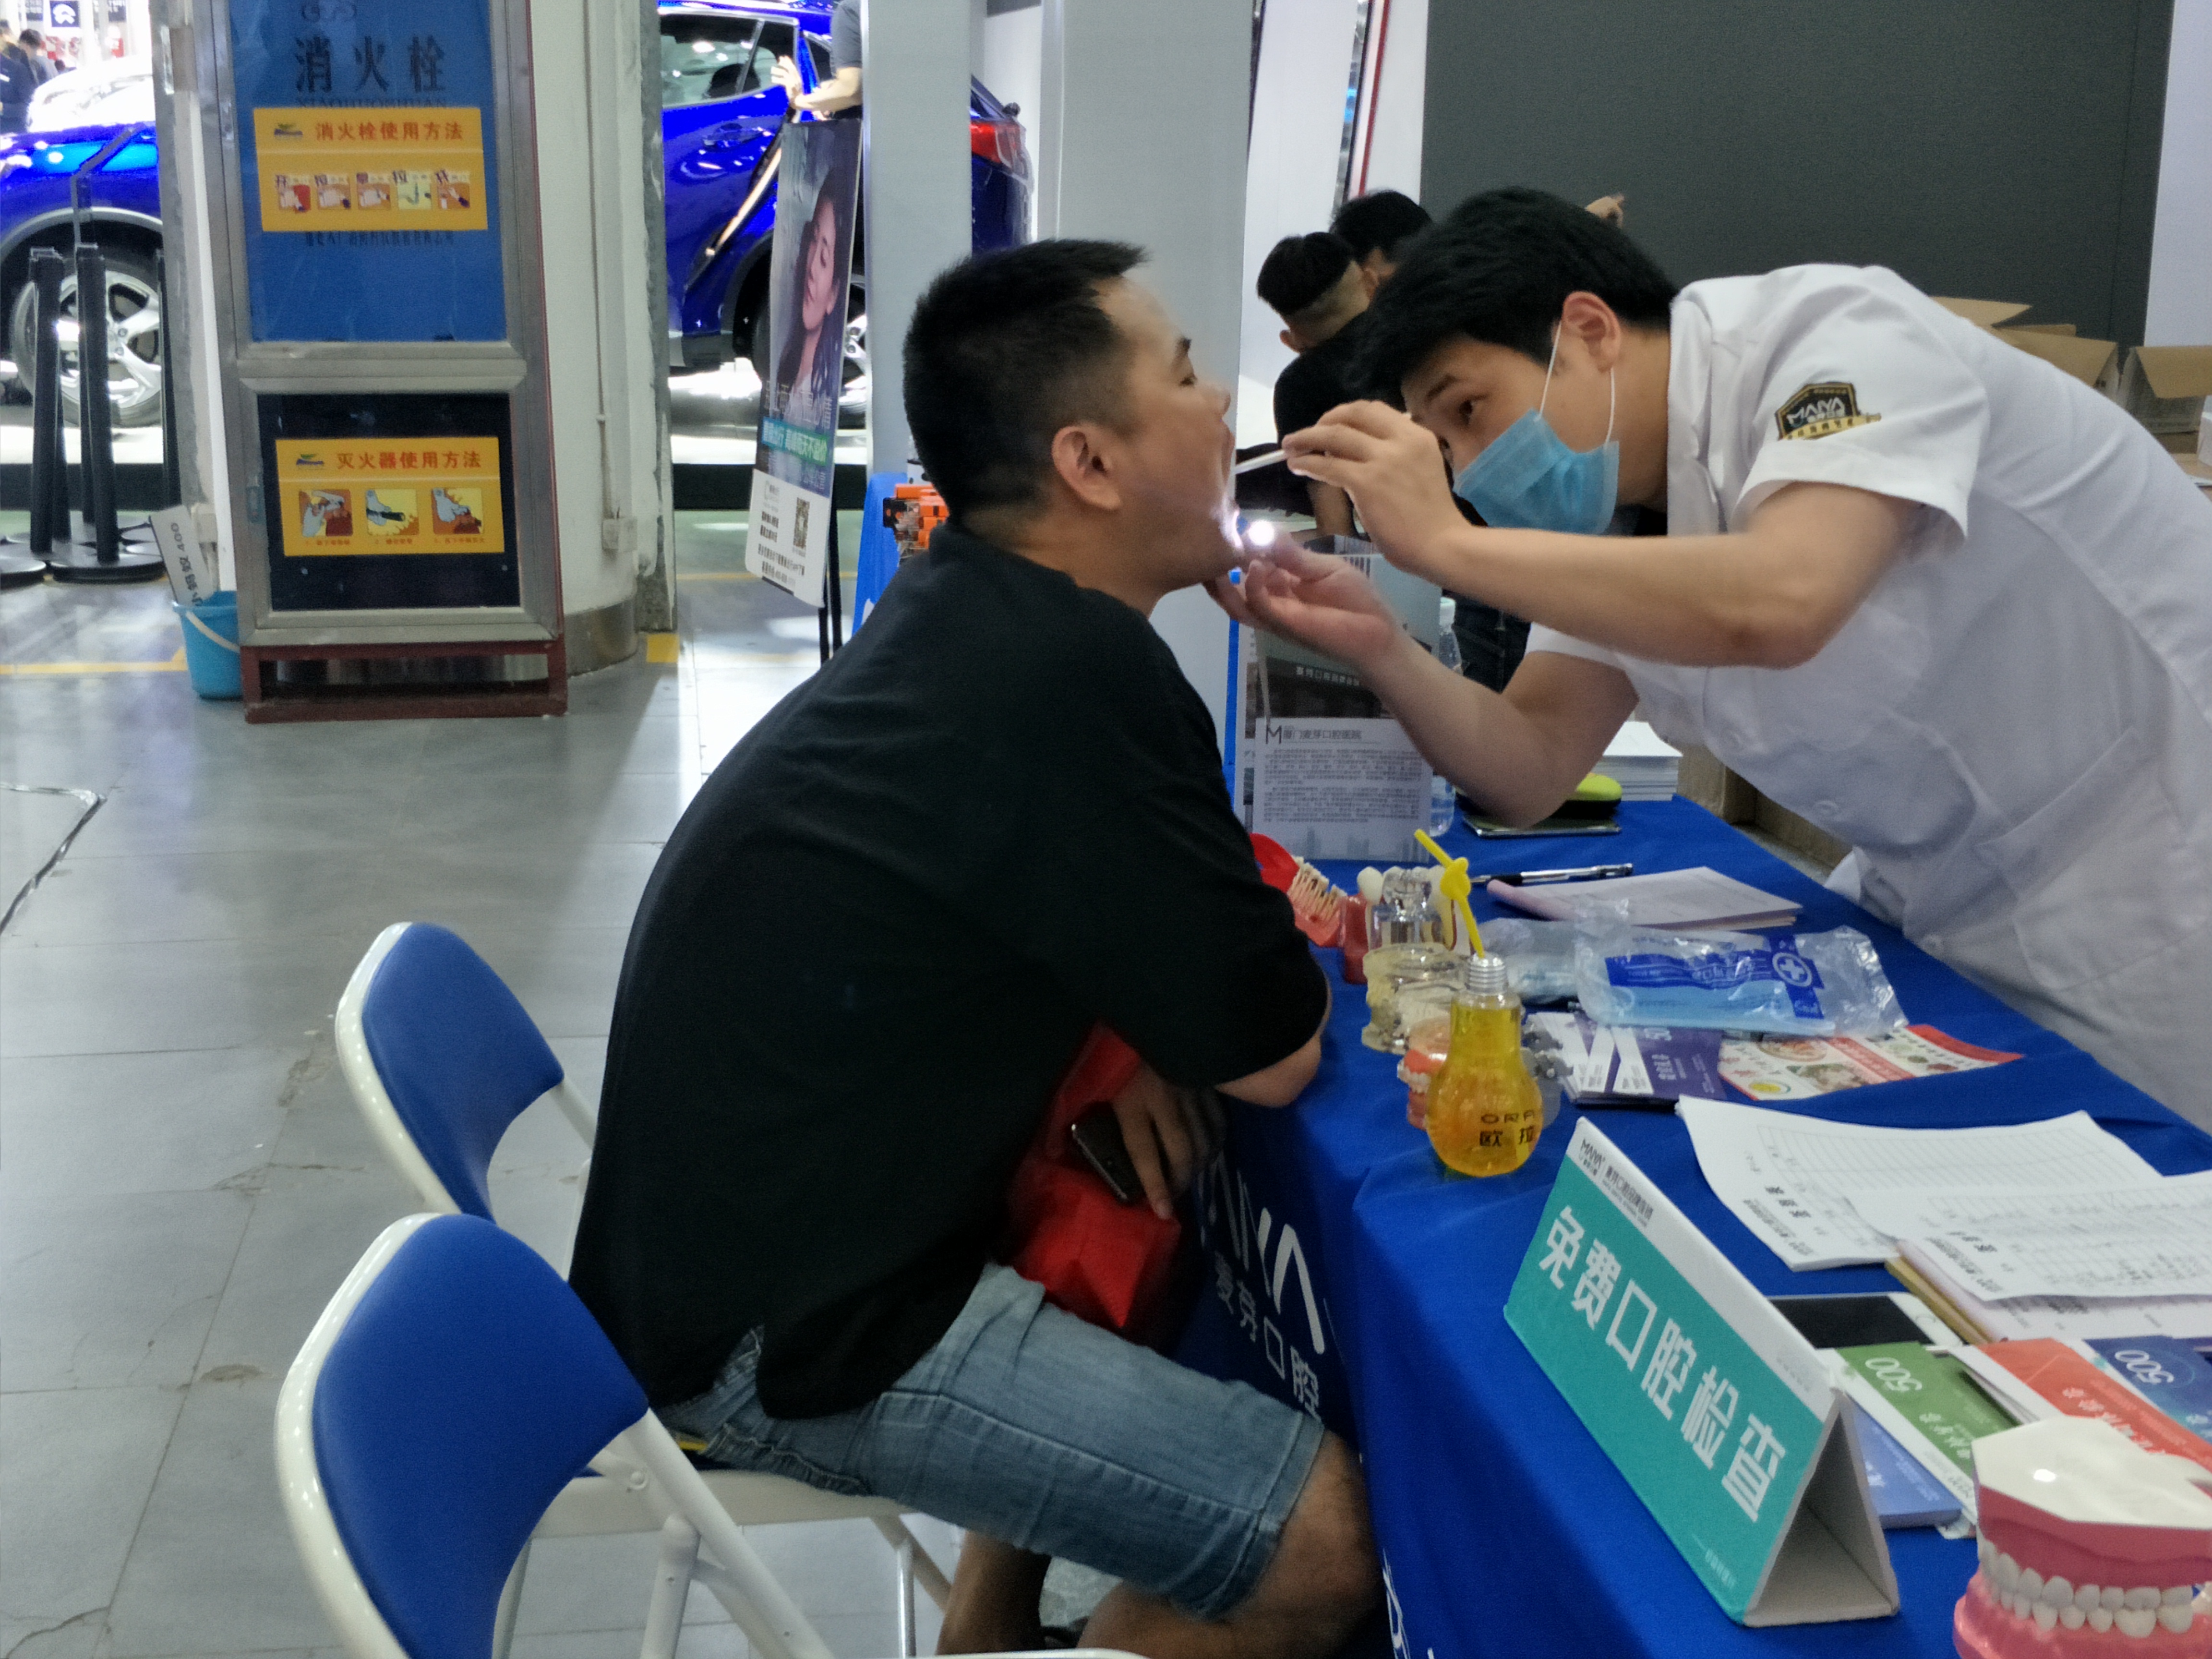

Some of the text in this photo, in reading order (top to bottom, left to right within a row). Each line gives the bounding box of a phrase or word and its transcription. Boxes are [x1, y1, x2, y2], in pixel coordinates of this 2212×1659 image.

[294, 35, 446, 93] 消火栓
[315, 121, 463, 141] 消火栓使用方法
[337, 451, 481, 469] 灭火器使用方法
[1479, 1126, 1535, 1147] 欧拉
[1539, 1205, 1786, 1522] 免费口腔检查
